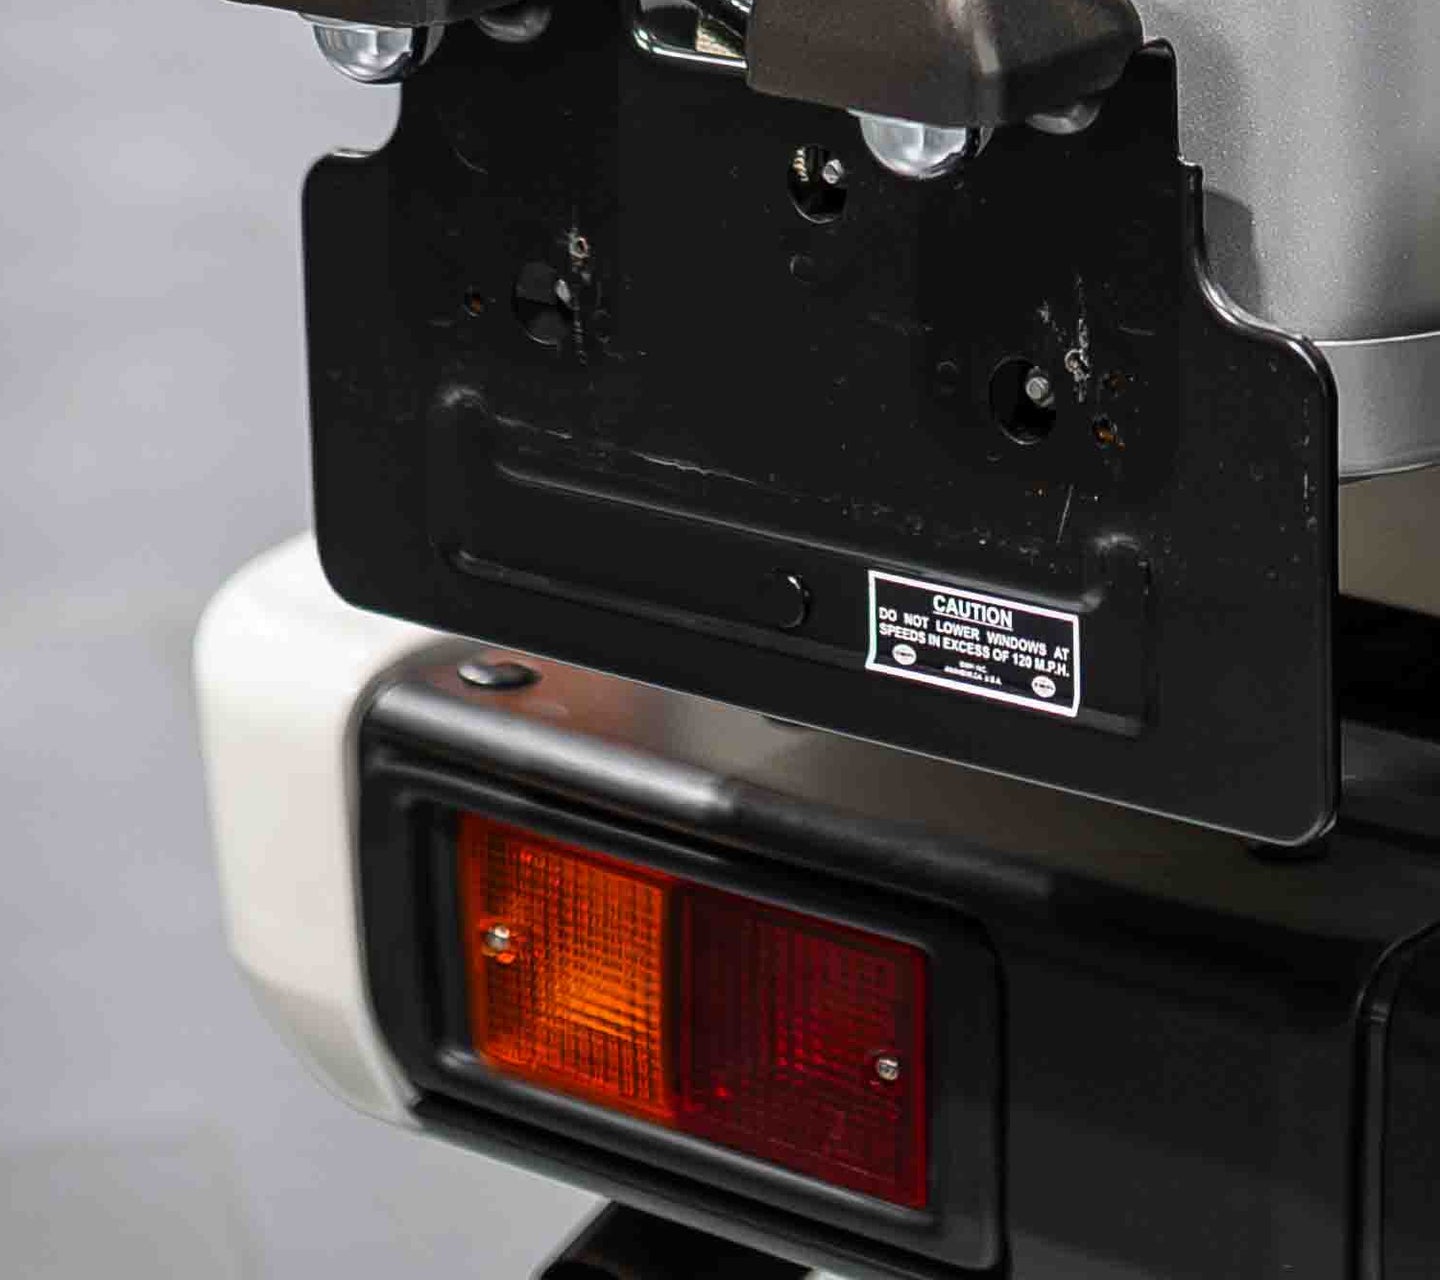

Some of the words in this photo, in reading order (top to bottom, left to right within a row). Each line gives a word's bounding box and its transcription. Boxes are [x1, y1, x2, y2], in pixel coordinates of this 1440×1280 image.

[879, 607, 897, 622] DO
[903, 612, 929, 629] NOT
[936, 619, 979, 641] LOWER
[986, 631, 1047, 657] WINDOWS
[1053, 646, 1070, 661] AT
[933, 594, 1013, 629] CAUTION
[879, 623, 926, 644] SPEEDS
[928, 633, 940, 647] IN
[942, 637, 990, 659] EXCESS
[992, 648, 1009, 663] OF
[1012, 652, 1032, 669] 120
[1034, 658, 1070, 677] M.P.H.
